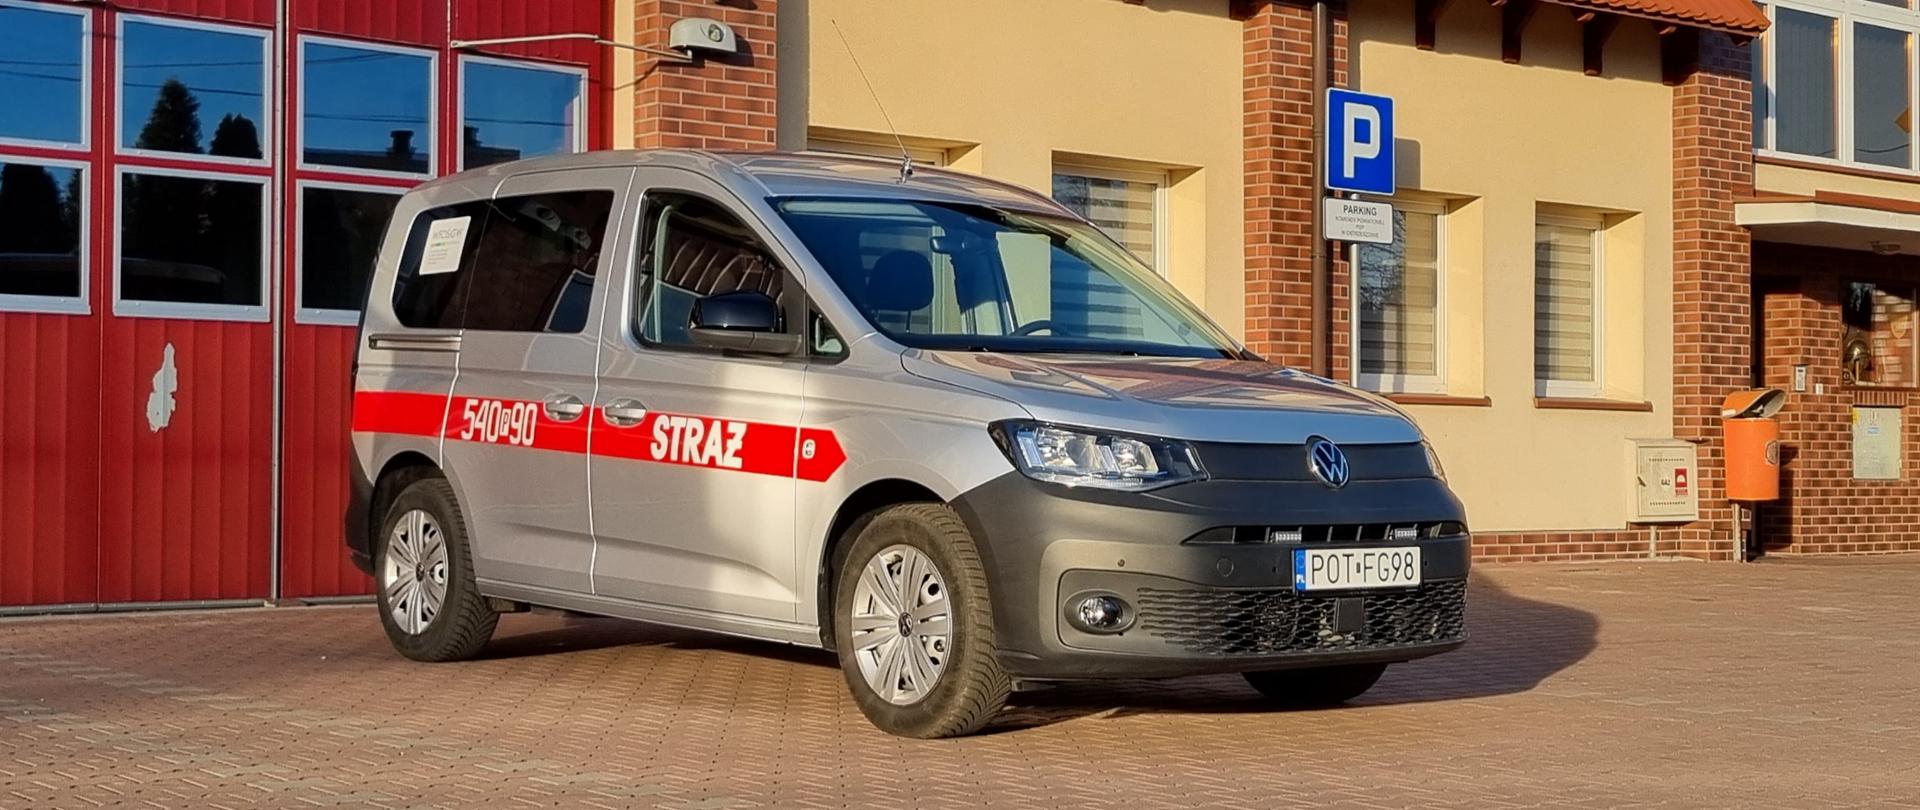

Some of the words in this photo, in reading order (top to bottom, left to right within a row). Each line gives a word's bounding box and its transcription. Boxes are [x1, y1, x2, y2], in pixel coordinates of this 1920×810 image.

[1344, 102, 1381, 178] P
[1343, 205, 1377, 216] PARKING
[650, 414, 747, 469] STRAŻ
[1312, 554, 1354, 585] POT
[1363, 551, 1414, 582] FG98
